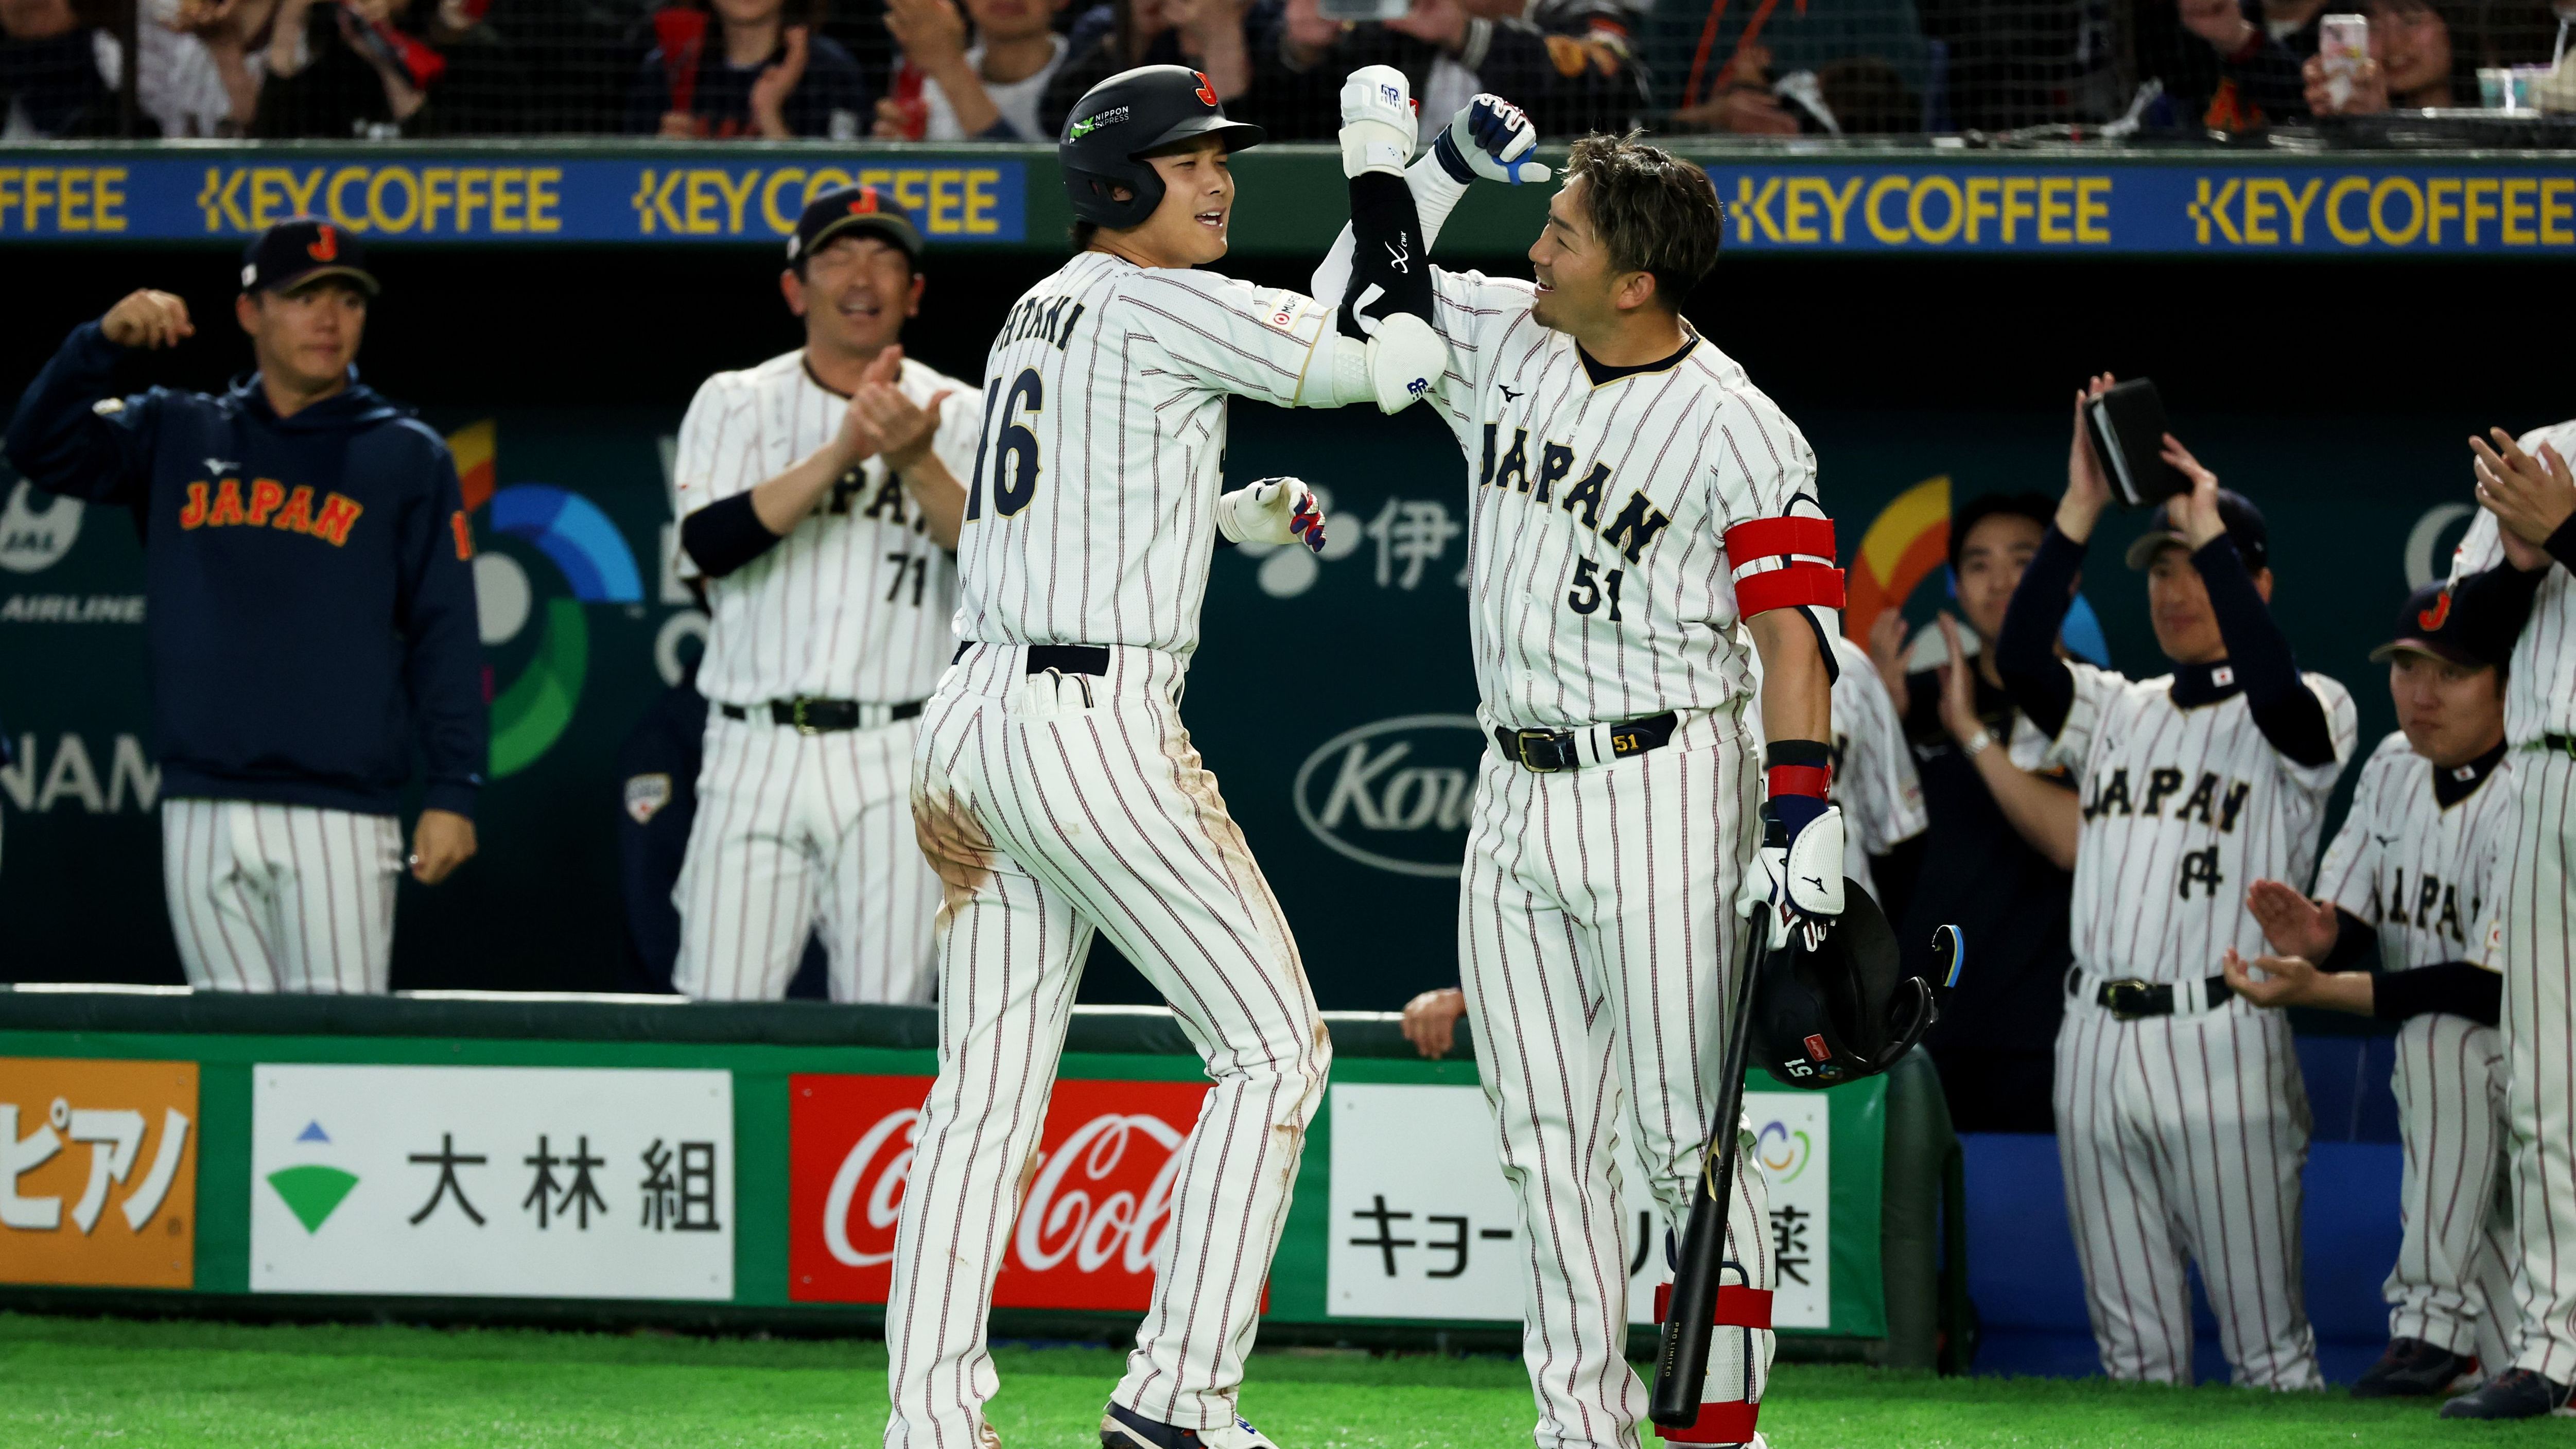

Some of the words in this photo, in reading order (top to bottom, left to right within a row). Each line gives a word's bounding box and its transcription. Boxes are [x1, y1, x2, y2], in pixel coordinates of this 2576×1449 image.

[1095, 106, 1128, 121] NIPPON
[1095, 113, 1129, 129] EXPRESS
[307, 225, 337, 262] J
[996, 295, 1086, 353] HTANI
[965, 364, 1044, 524] 16
[180, 477, 363, 547] JAPAN
[1480, 421, 1672, 567] JAPAN
[886, 552, 926, 606] 71
[1568, 553, 1624, 623] 51
[2418, 591, 2451, 632] J
[1613, 734, 1639, 752] 51
[1784, 1058, 1813, 1077] 51
[408, 1132, 721, 1232] 大林組
[1665, 1342, 1676, 1377] LIMITED
